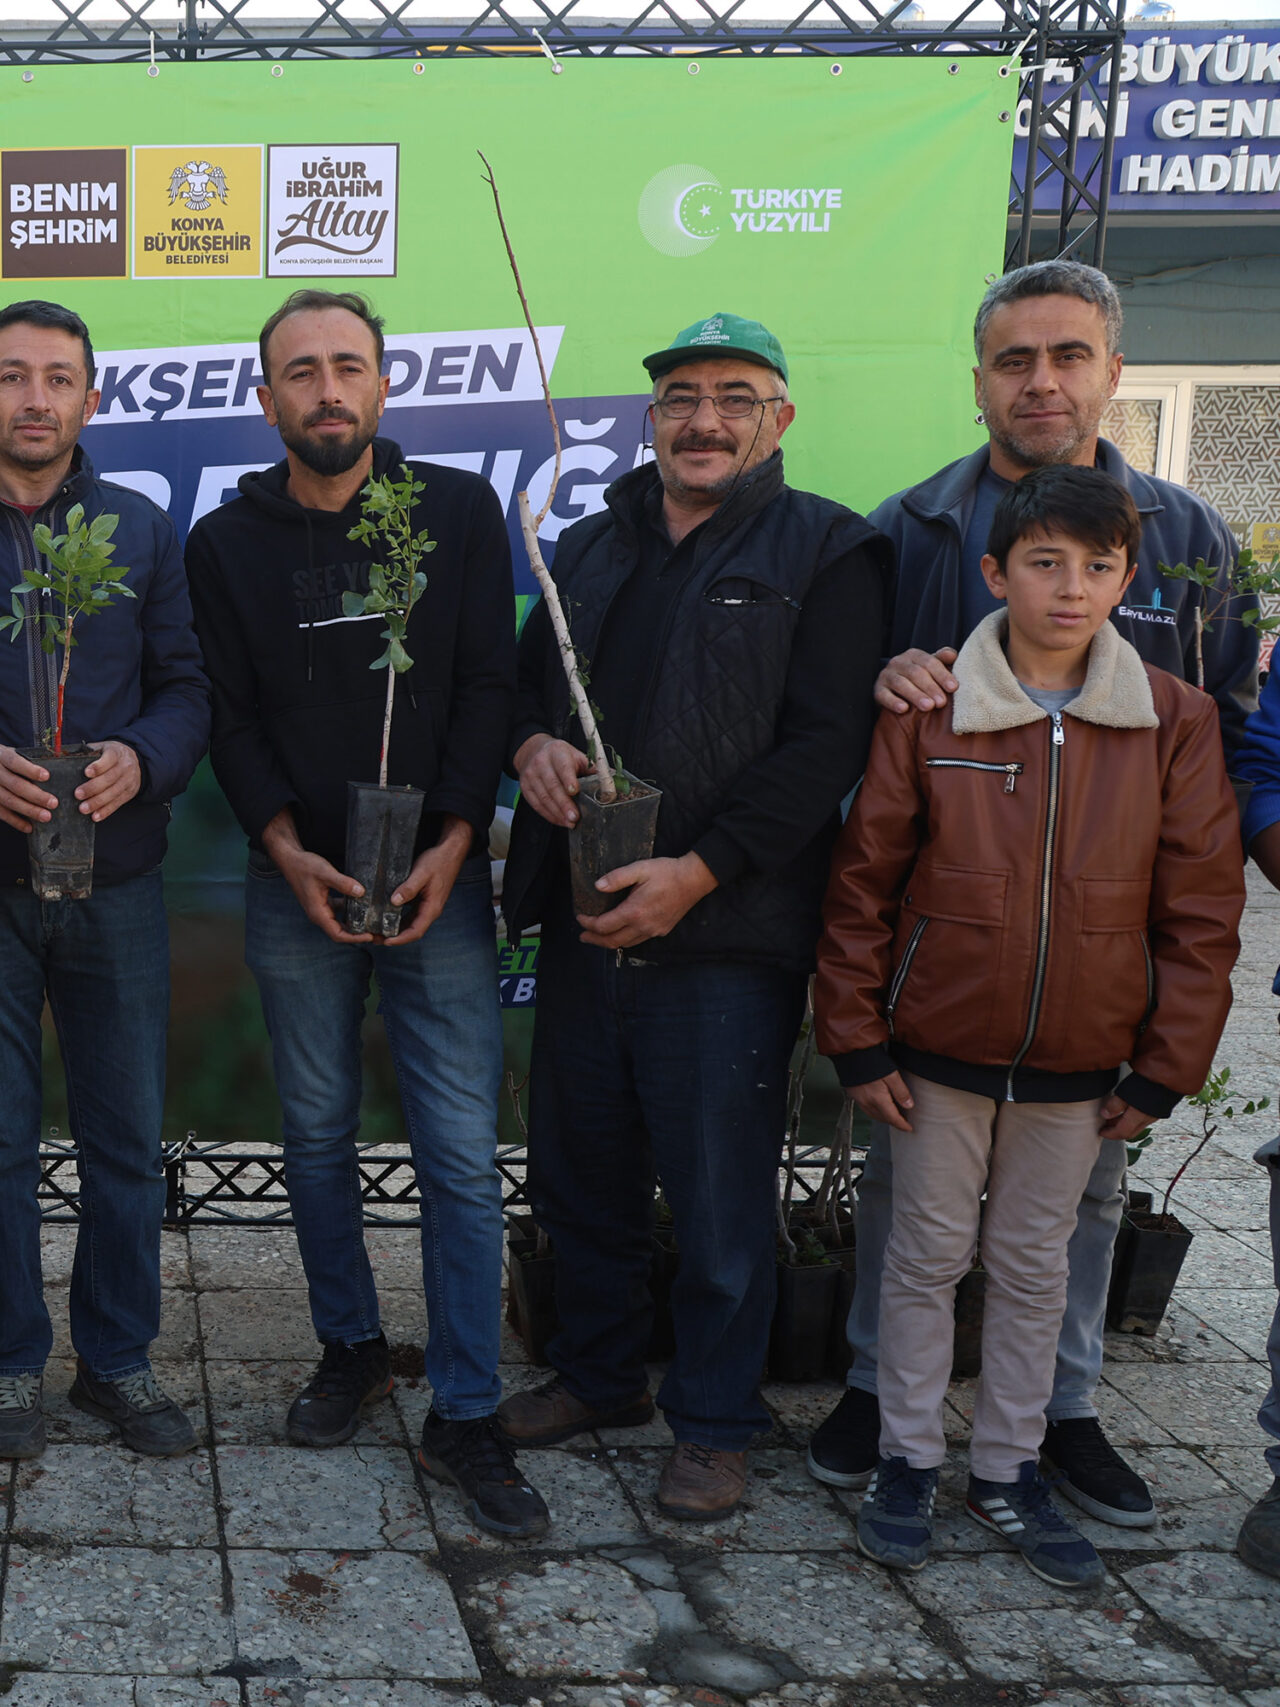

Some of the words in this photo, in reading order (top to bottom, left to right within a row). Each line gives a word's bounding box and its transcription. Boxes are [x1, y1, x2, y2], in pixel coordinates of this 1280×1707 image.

[301, 157, 366, 179] UĞUR
[171, 217, 225, 231] KONYA
[276, 199, 389, 255] Altay
